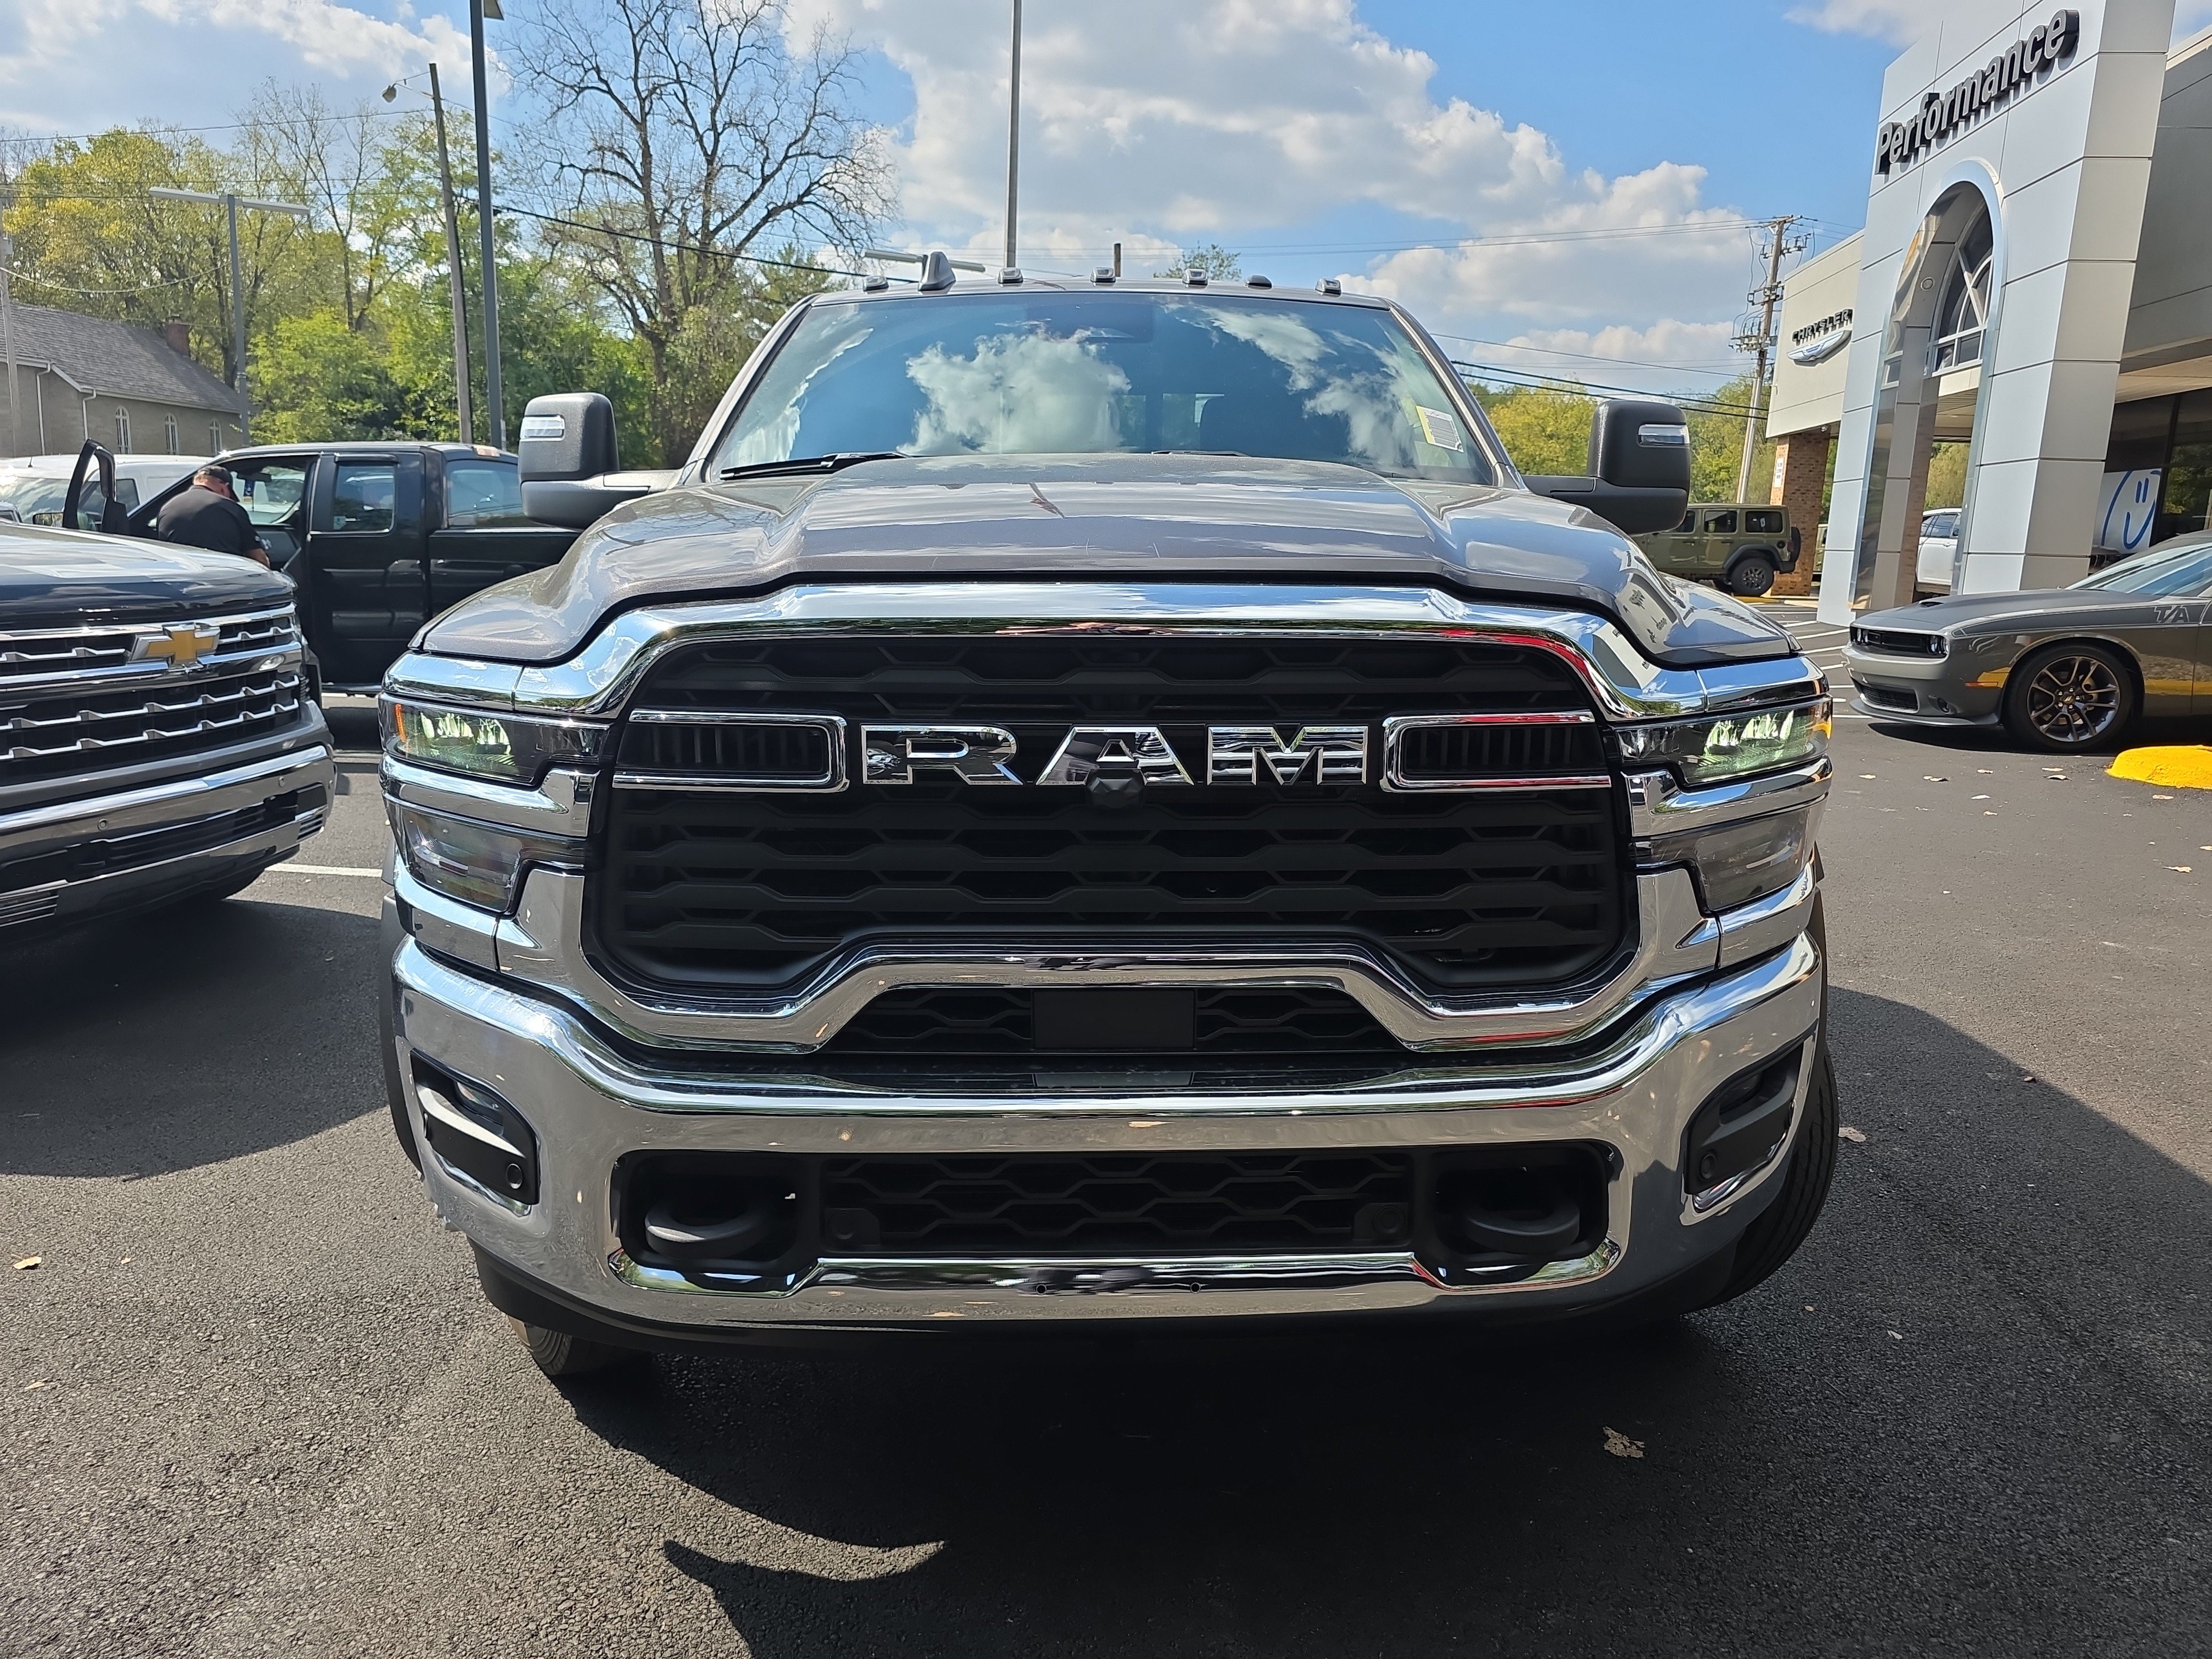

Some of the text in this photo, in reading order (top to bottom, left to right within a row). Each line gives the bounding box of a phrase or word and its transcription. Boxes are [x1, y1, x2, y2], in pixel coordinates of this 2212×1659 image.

[1875, 9, 2078, 175] Performance
[1792, 309, 1852, 342] CHRYSLER
[861, 725, 1368, 786] RAM
